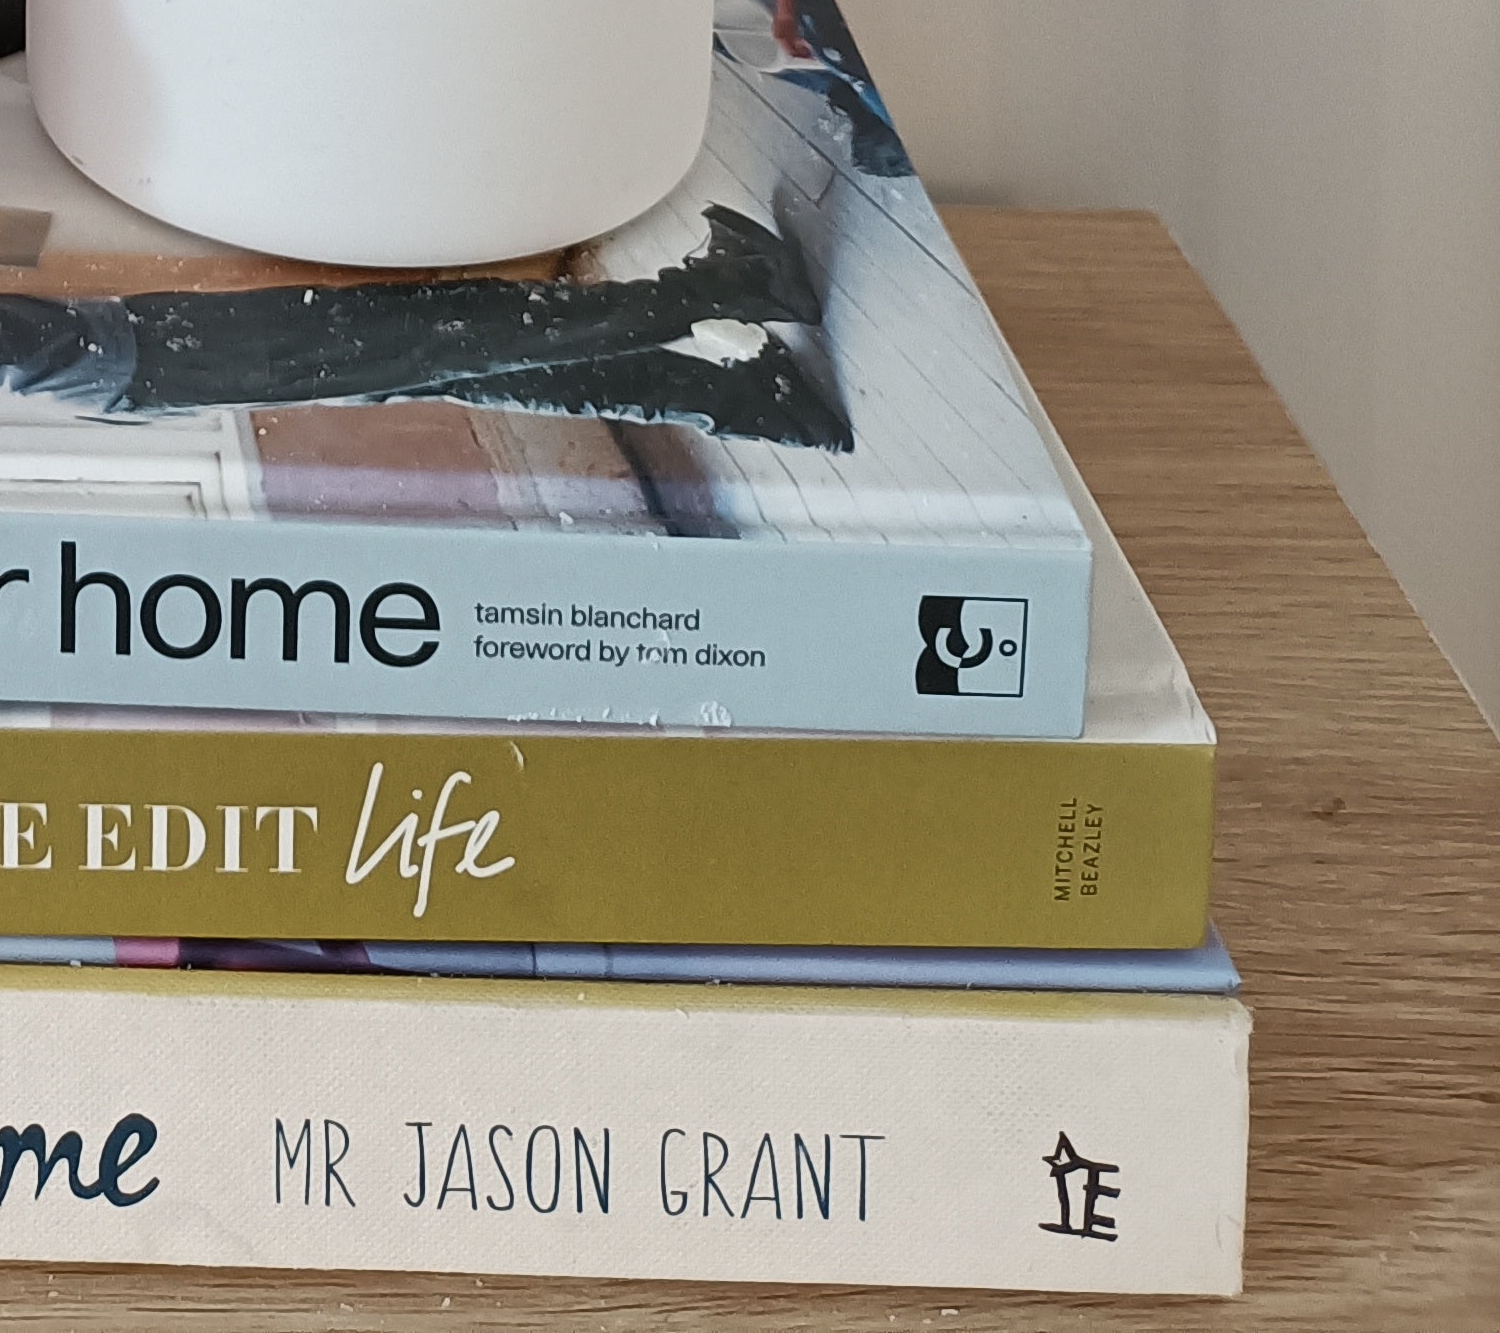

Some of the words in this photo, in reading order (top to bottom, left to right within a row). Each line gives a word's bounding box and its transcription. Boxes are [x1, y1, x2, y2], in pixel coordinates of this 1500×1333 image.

[60, 540, 441, 668] home
[474, 602, 563, 627] tamsin
[570, 604, 700, 632] blanchard
[473, 634, 591, 662] foreword
[599, 639, 630, 668] by
[695, 643, 766, 667] dixon
[78, 803, 318, 873] EDIT
[1053, 797, 1078, 901] MITCHELL
[1080, 803, 1104, 896] BEAZLEY
[275, 1118, 356, 1208] MR
[403, 1121, 610, 1215] JASON
[660, 1128, 886, 1222] GRANT
